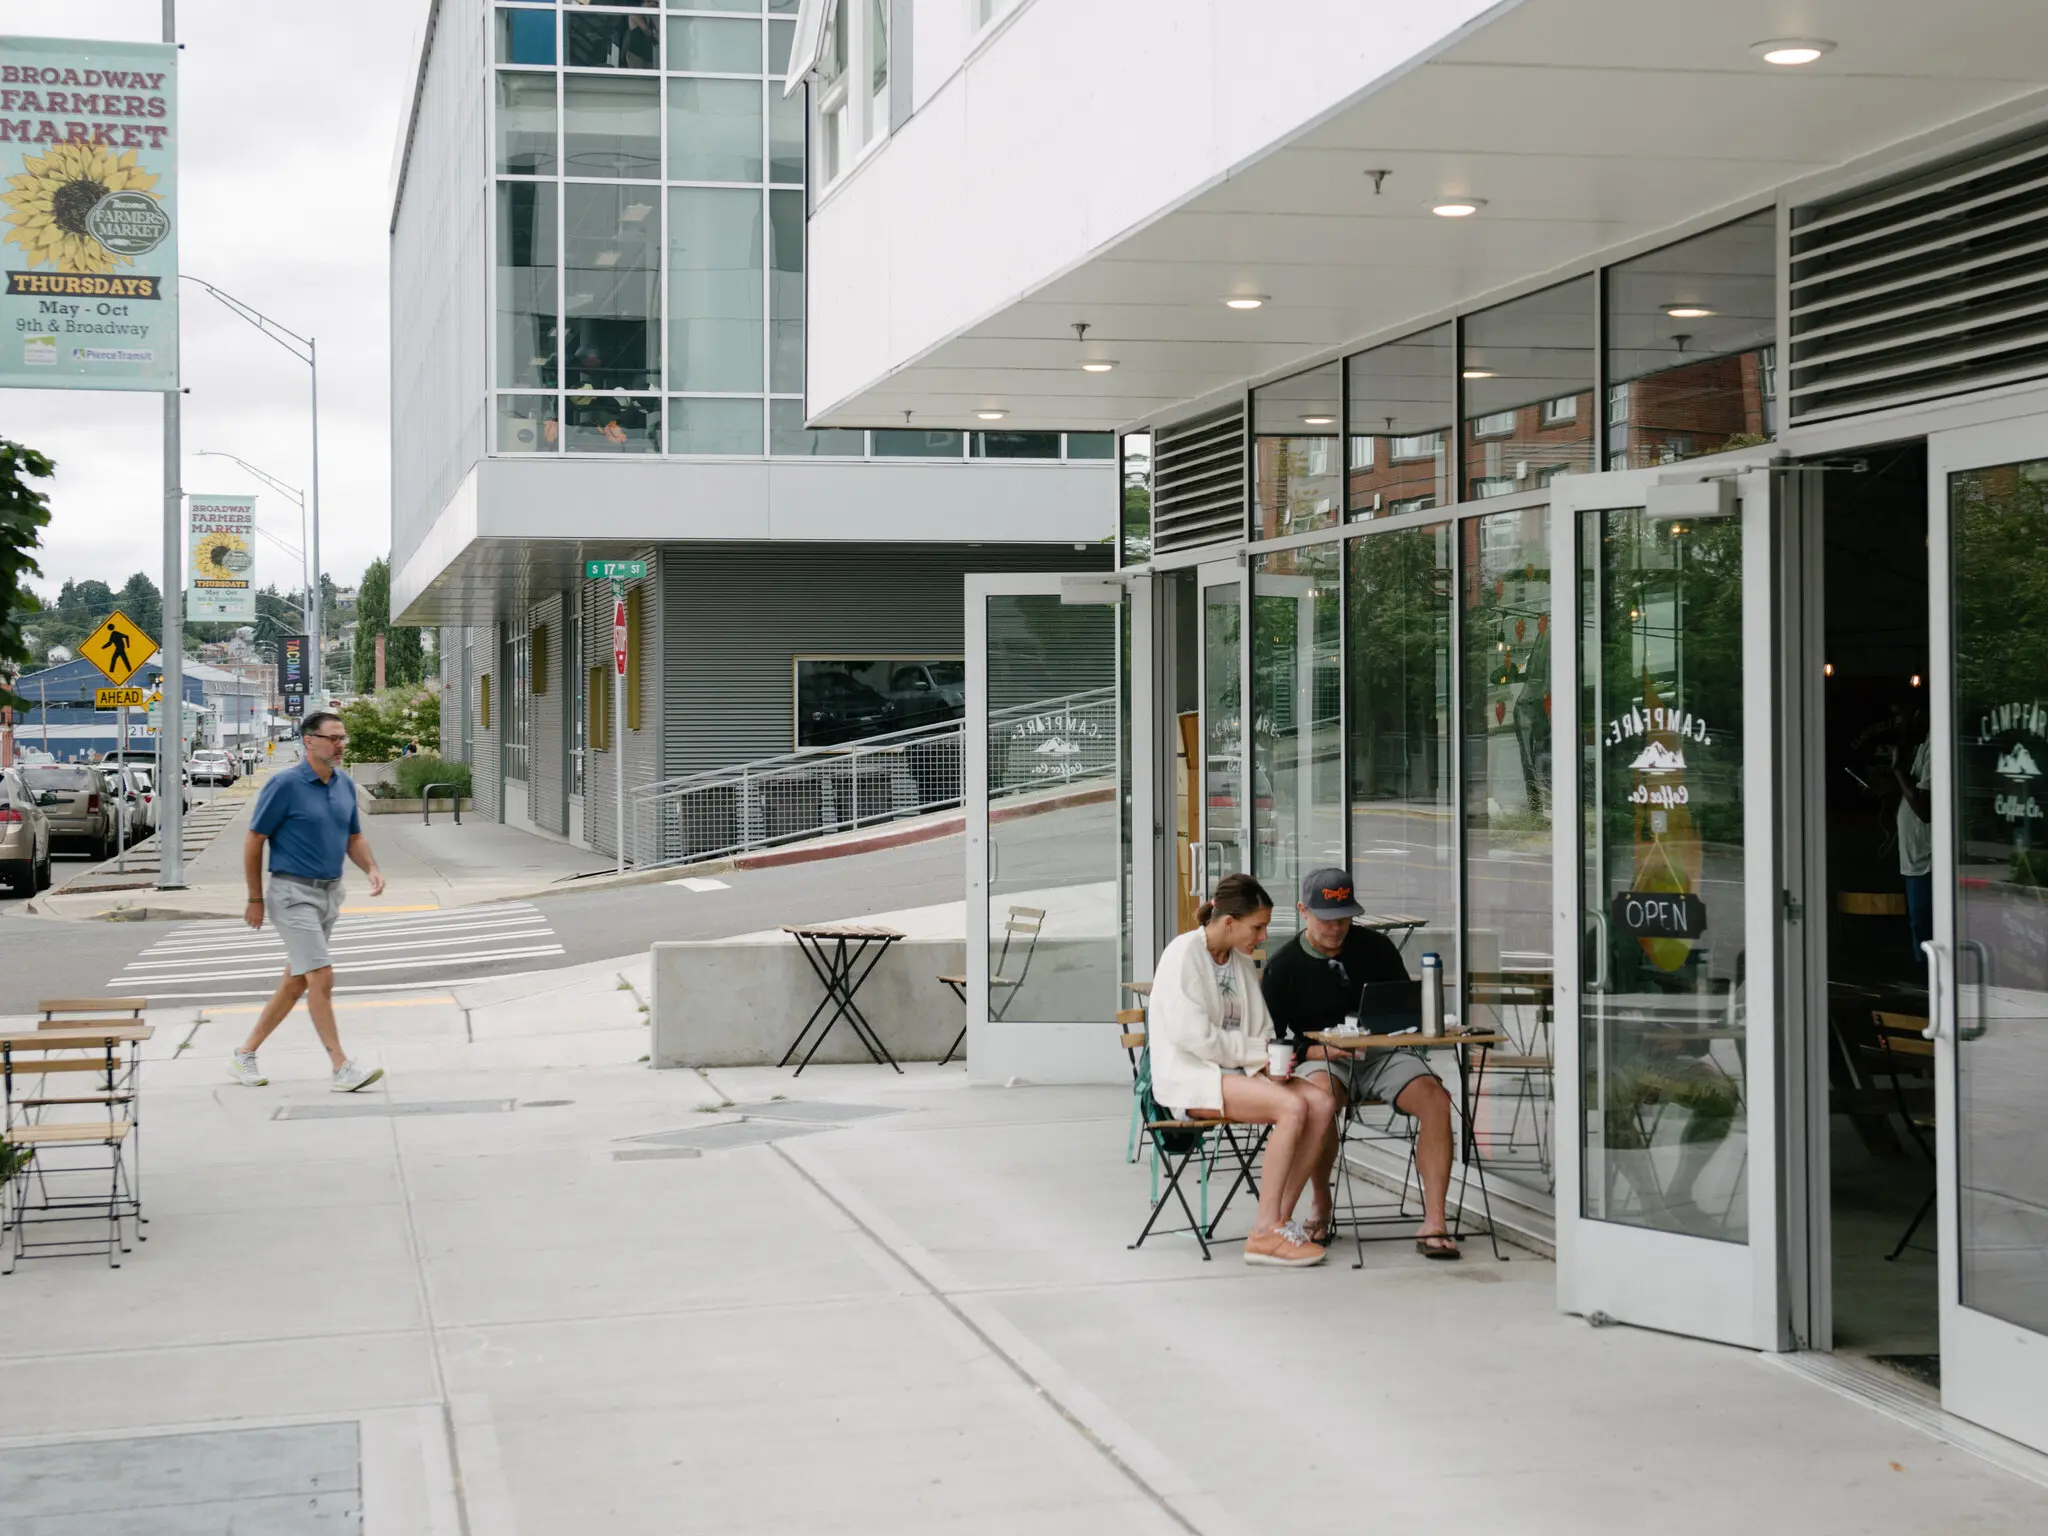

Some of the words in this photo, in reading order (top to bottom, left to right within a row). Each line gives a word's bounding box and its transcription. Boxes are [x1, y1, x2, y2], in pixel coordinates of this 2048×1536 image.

[1, 65, 166, 90] BROADWAY
[0, 89, 168, 118] FARMERS
[0, 118, 168, 149] MARKET
[94, 209, 166, 225] FARMERS
[98, 222, 163, 238] MARKET
[13, 274, 153, 297] THURSDAYS
[39, 300, 80, 318] May
[96, 302, 129, 317] Oct
[16, 318, 43, 332] 9th
[47, 319, 60, 333] &
[64, 319, 150, 339] Broadway
[192, 504, 252, 513] BROADWAY
[192, 513, 252, 524] FARMERS
[191, 524, 253, 535] MARKET
[592, 565, 598, 575] S
[630, 564, 641, 574] ST
[196, 580, 248, 589] THURSDAYS
[286, 640, 301, 681] TACOMA
[100, 691, 140, 704] AHEAD
[1981, 698, 2048, 742] CAMPFIR
[1626, 900, 1687, 931] OPEN
